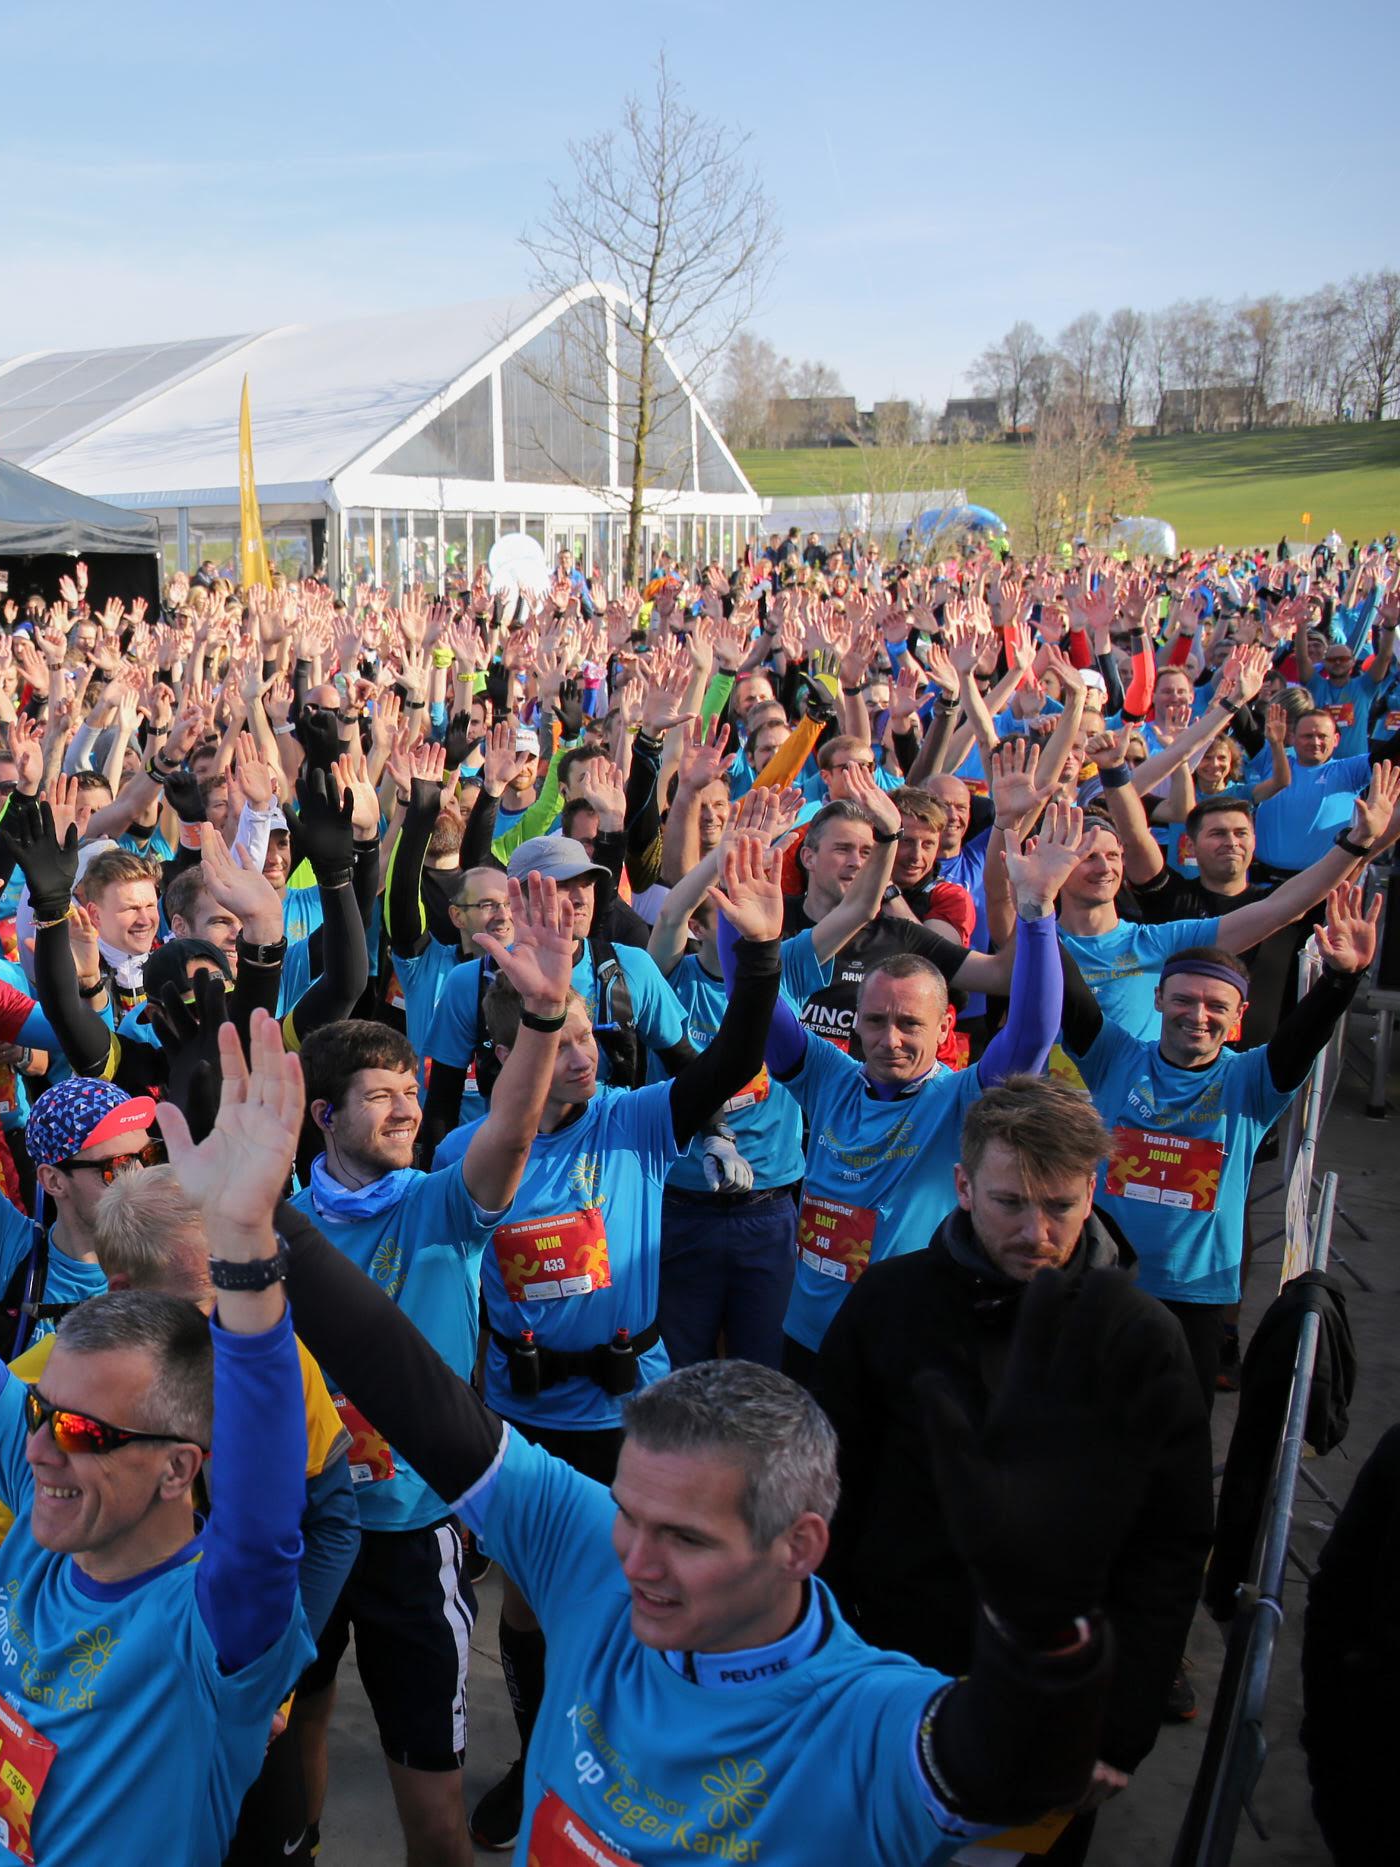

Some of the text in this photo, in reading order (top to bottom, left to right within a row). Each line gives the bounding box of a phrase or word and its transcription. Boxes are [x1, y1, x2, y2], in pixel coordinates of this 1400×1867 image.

[1142, 1133, 1190, 1149] Team Tine
[1148, 1149, 1182, 1164] JOHAN
[843, 1170, 861, 1181] 2019
[1159, 1170, 1166, 1181] 1
[815, 1212, 838, 1230] BART
[535, 1235, 562, 1251] WIM
[815, 1235, 831, 1250] 148
[543, 1257, 566, 1272] 433
[1, 1637, 18, 1666] op
[719, 1657, 791, 1684] PEUTIE
[574, 1750, 606, 1785] op
